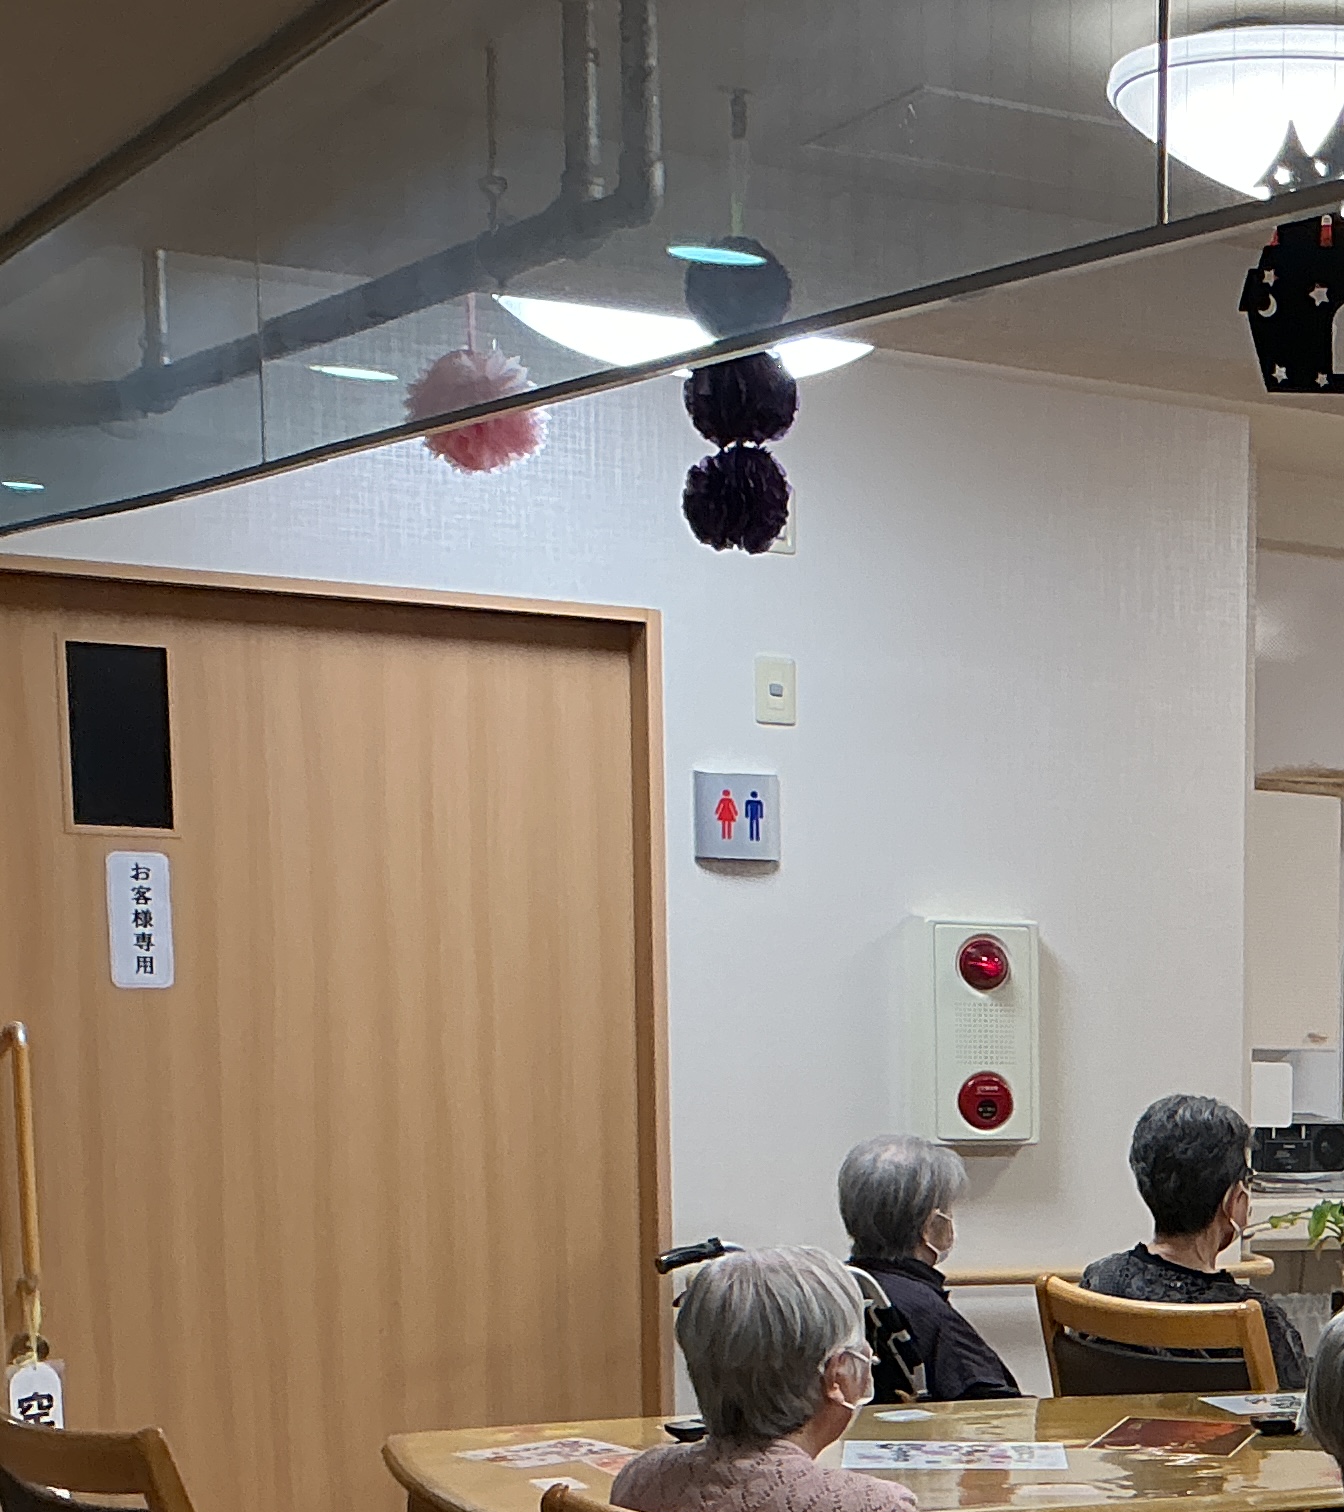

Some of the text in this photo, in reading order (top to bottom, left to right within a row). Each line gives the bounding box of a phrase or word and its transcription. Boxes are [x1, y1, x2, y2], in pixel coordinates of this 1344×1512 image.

[130, 862, 155, 974] お客様専用
